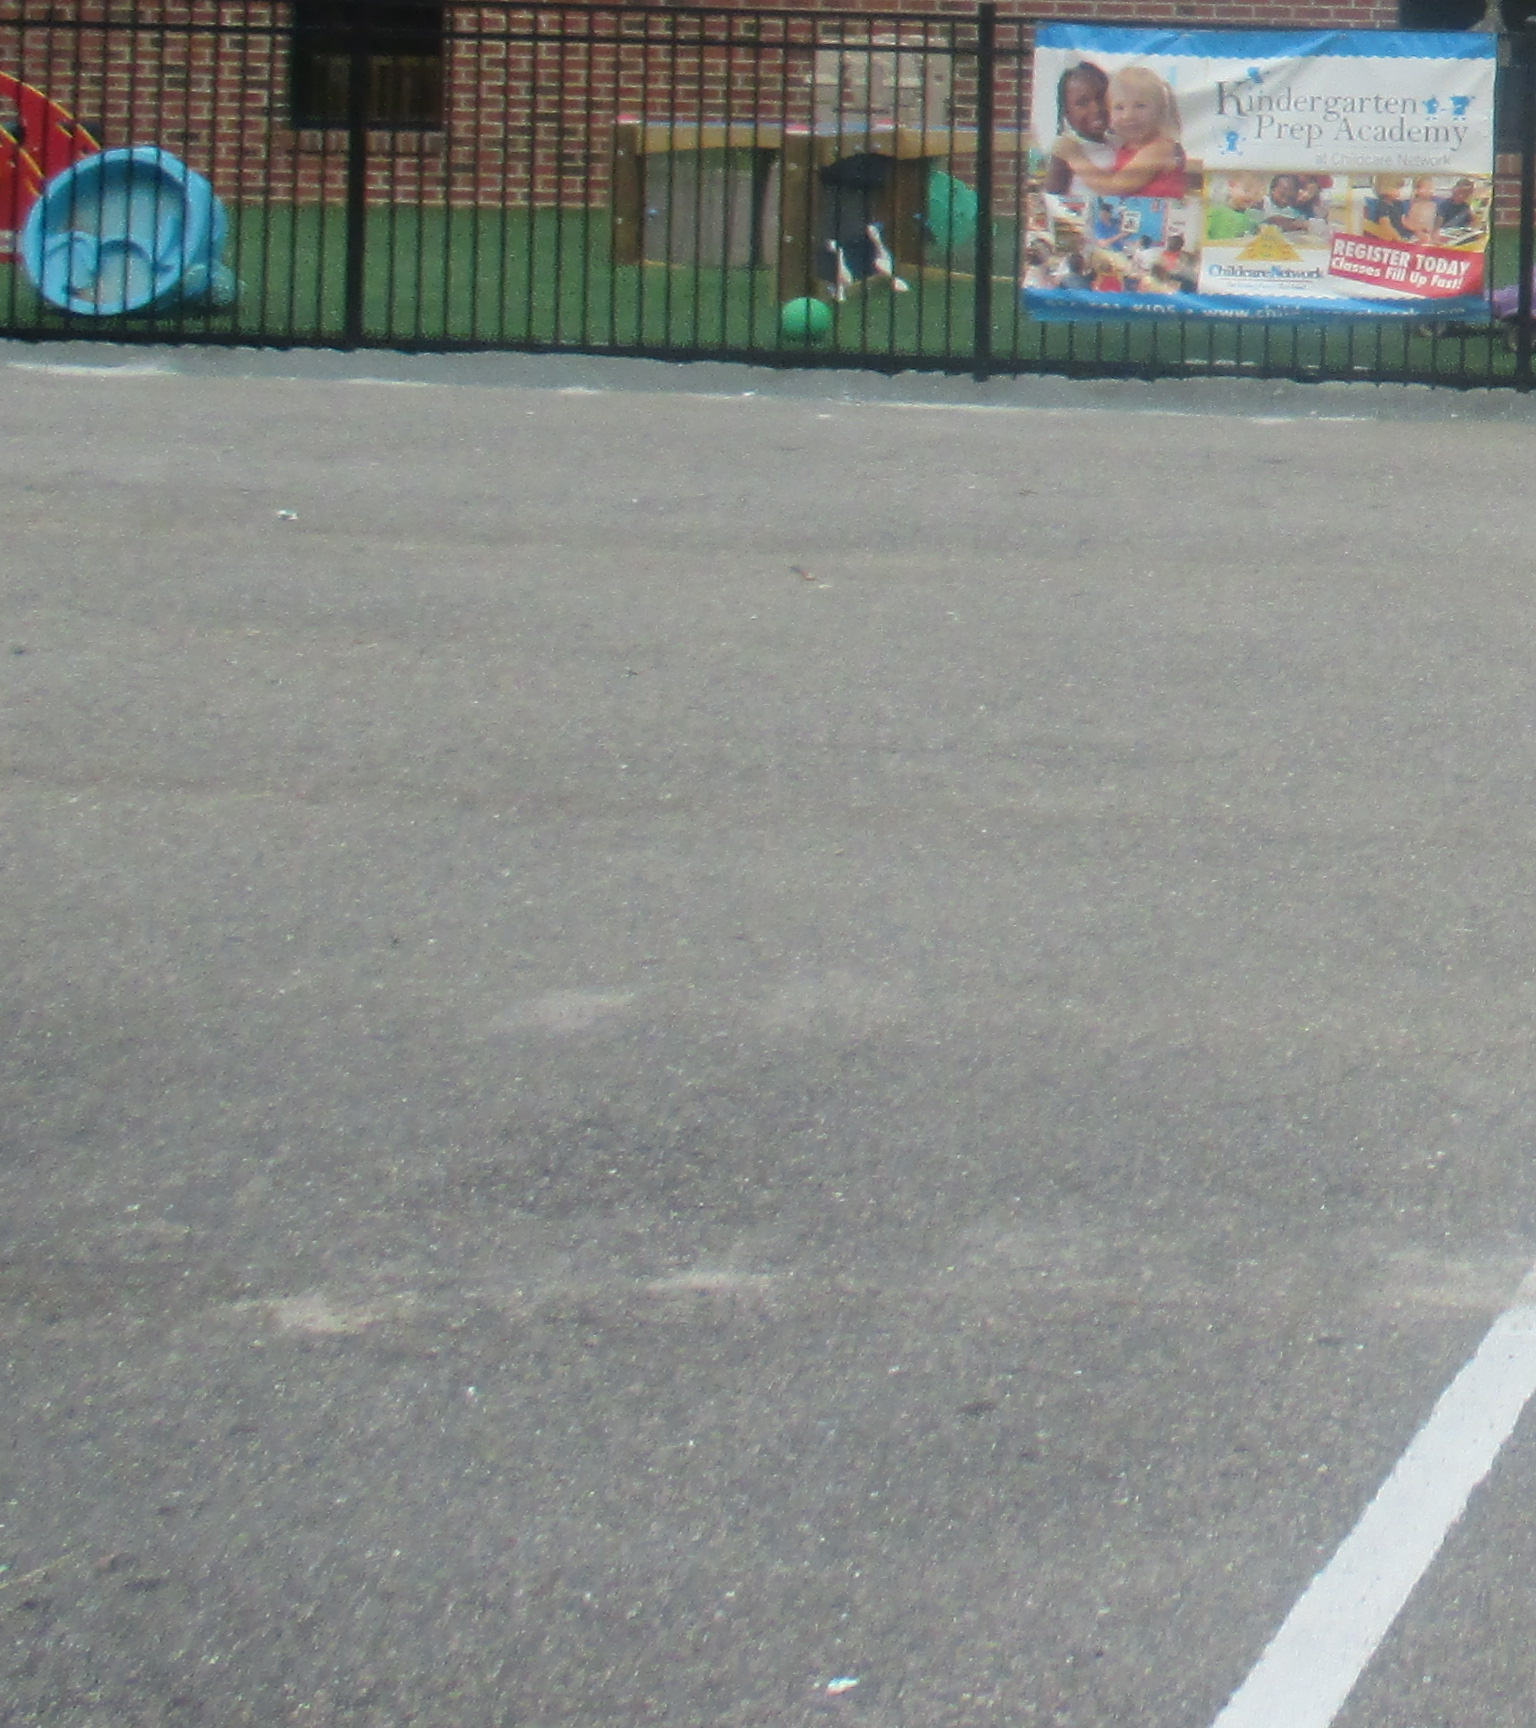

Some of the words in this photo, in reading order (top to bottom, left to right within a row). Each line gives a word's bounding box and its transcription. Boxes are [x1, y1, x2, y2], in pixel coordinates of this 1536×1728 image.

[1215, 81, 1417, 122] Kindergarten
[1254, 115, 1323, 148] Prep
[1333, 117, 1469, 152] Academy
[1332, 256, 1381, 278] Classes
[1385, 265, 1405, 281] Fill
[1410, 271, 1428, 288] Up
[1431, 275, 1465, 290] Fast!
[1333, 238, 1411, 268] REGISTER
[1415, 252, 1472, 277] TODAY
